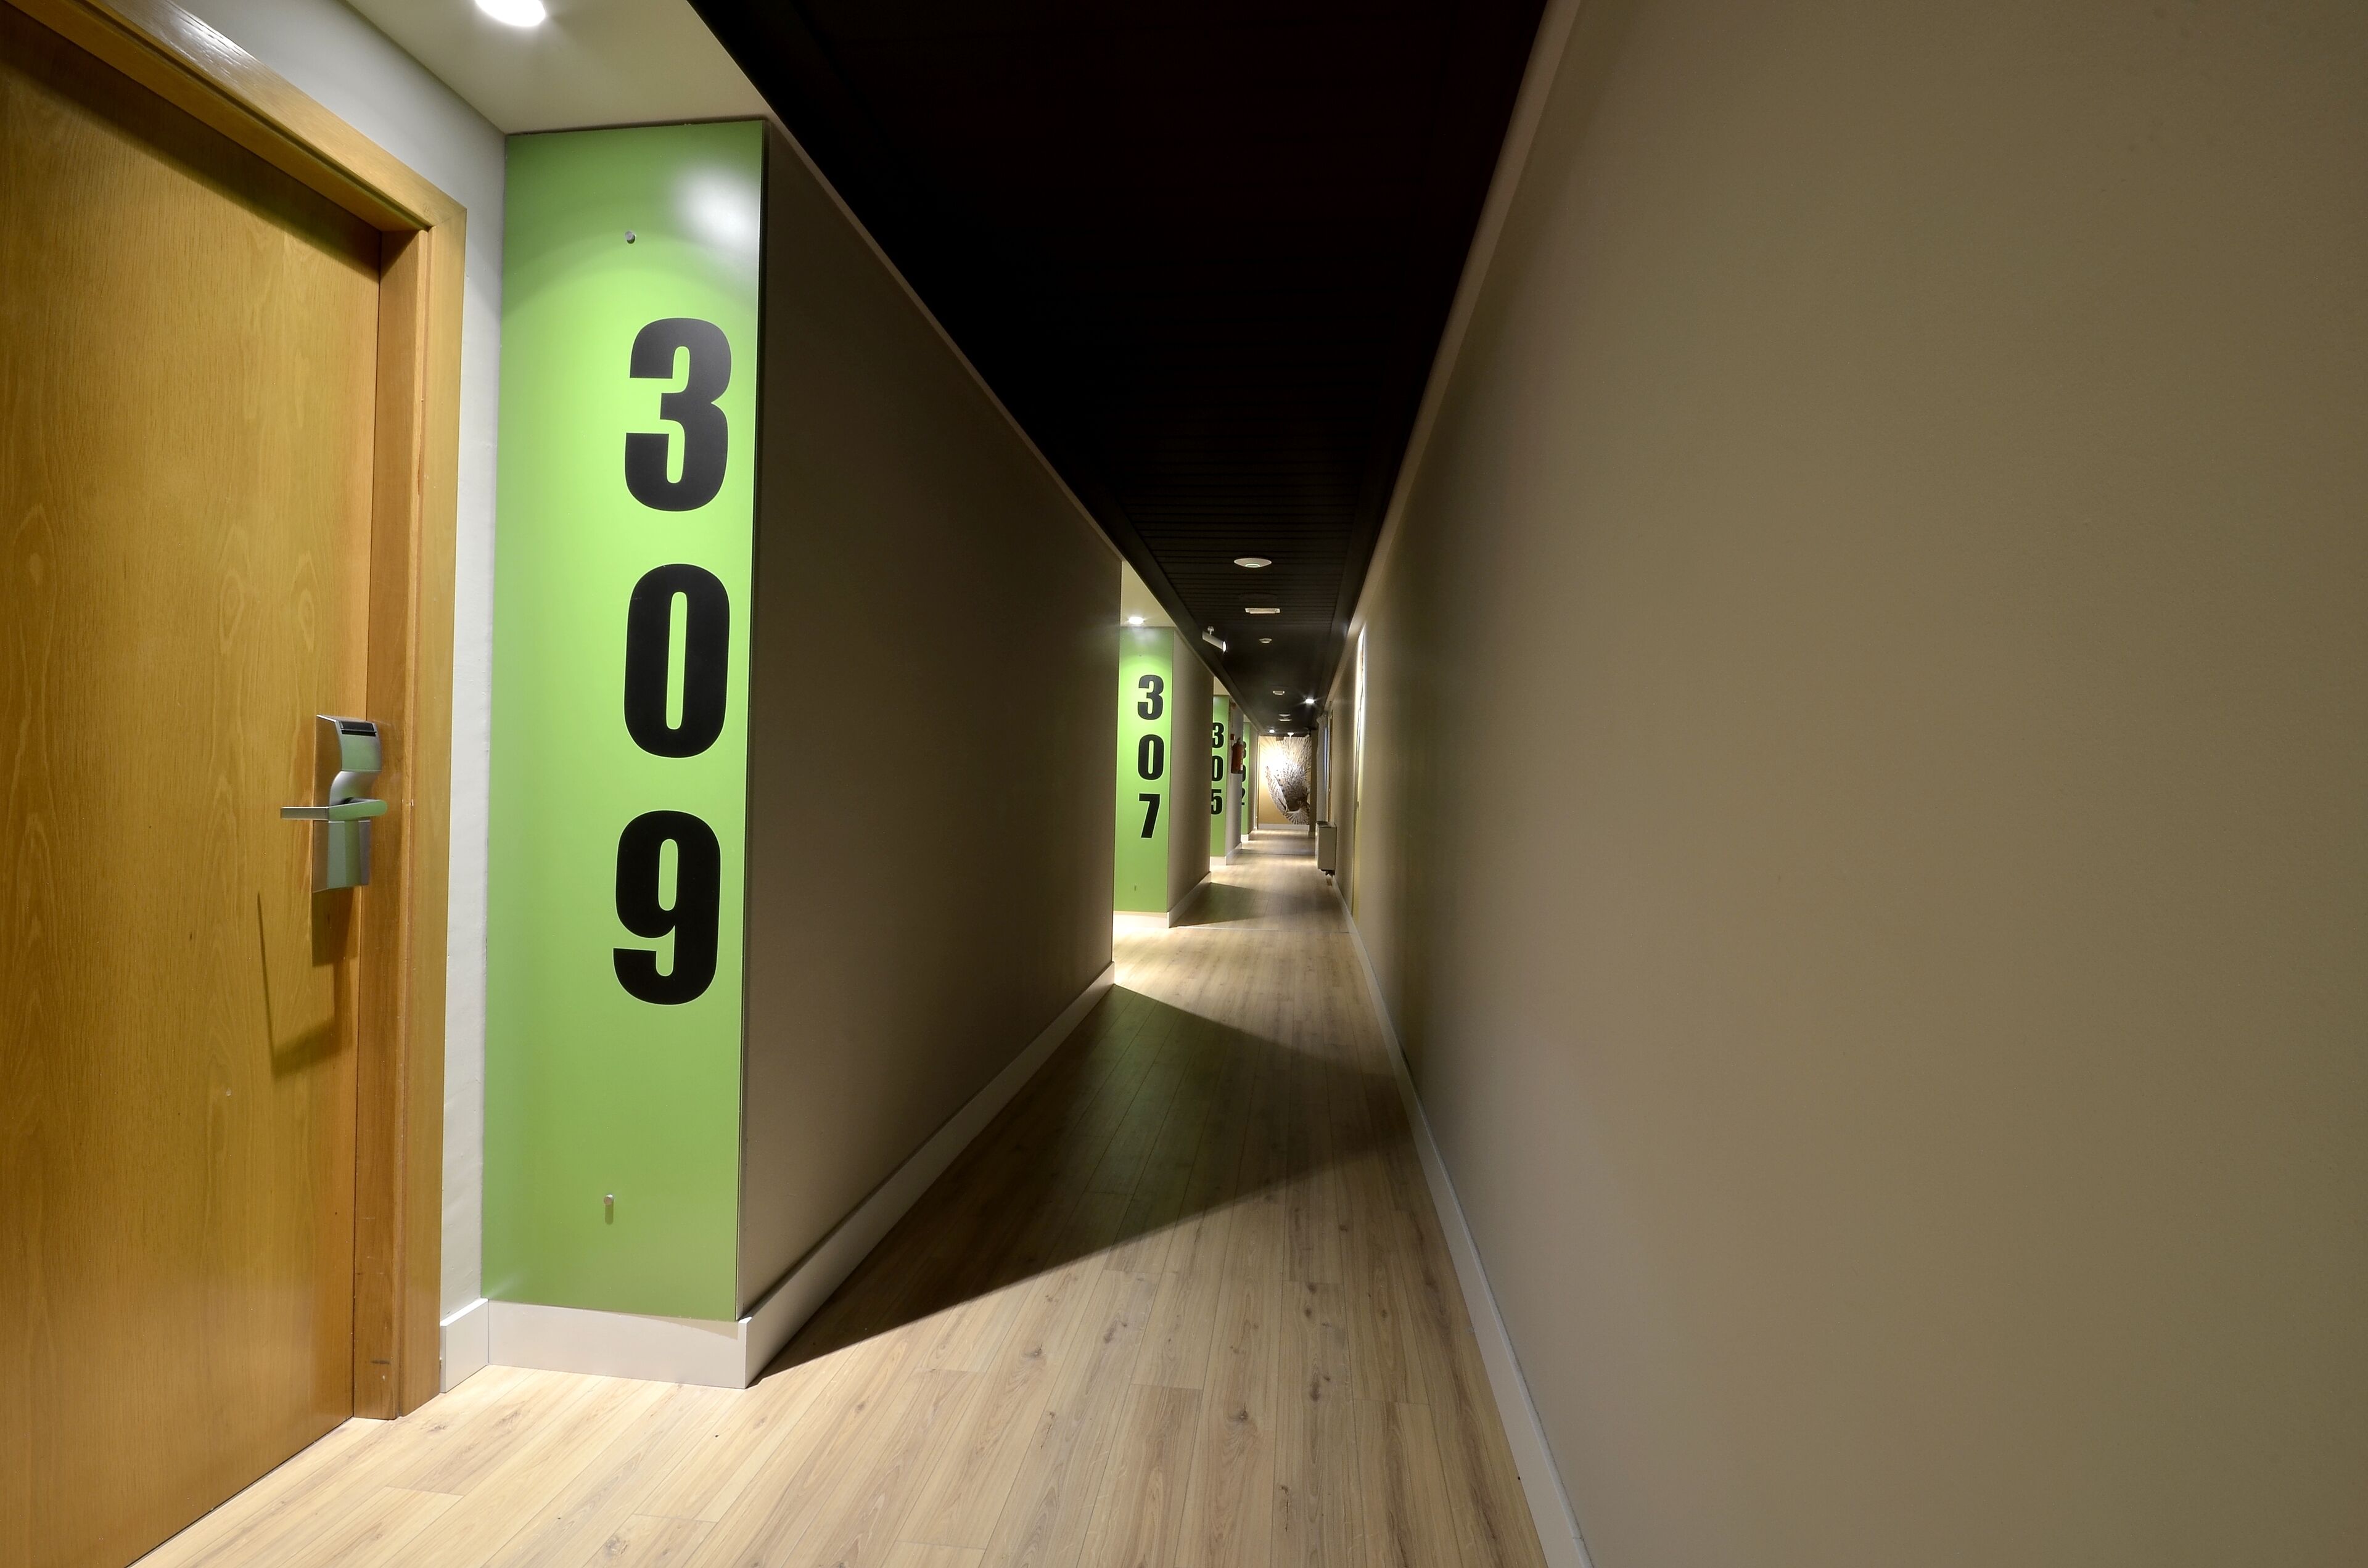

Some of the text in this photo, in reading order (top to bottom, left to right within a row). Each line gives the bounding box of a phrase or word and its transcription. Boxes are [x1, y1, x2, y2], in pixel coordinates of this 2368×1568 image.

[613, 317, 732, 1005] 309
[1137, 675, 1164, 839] 307
[1211, 722, 1224, 815] 305
